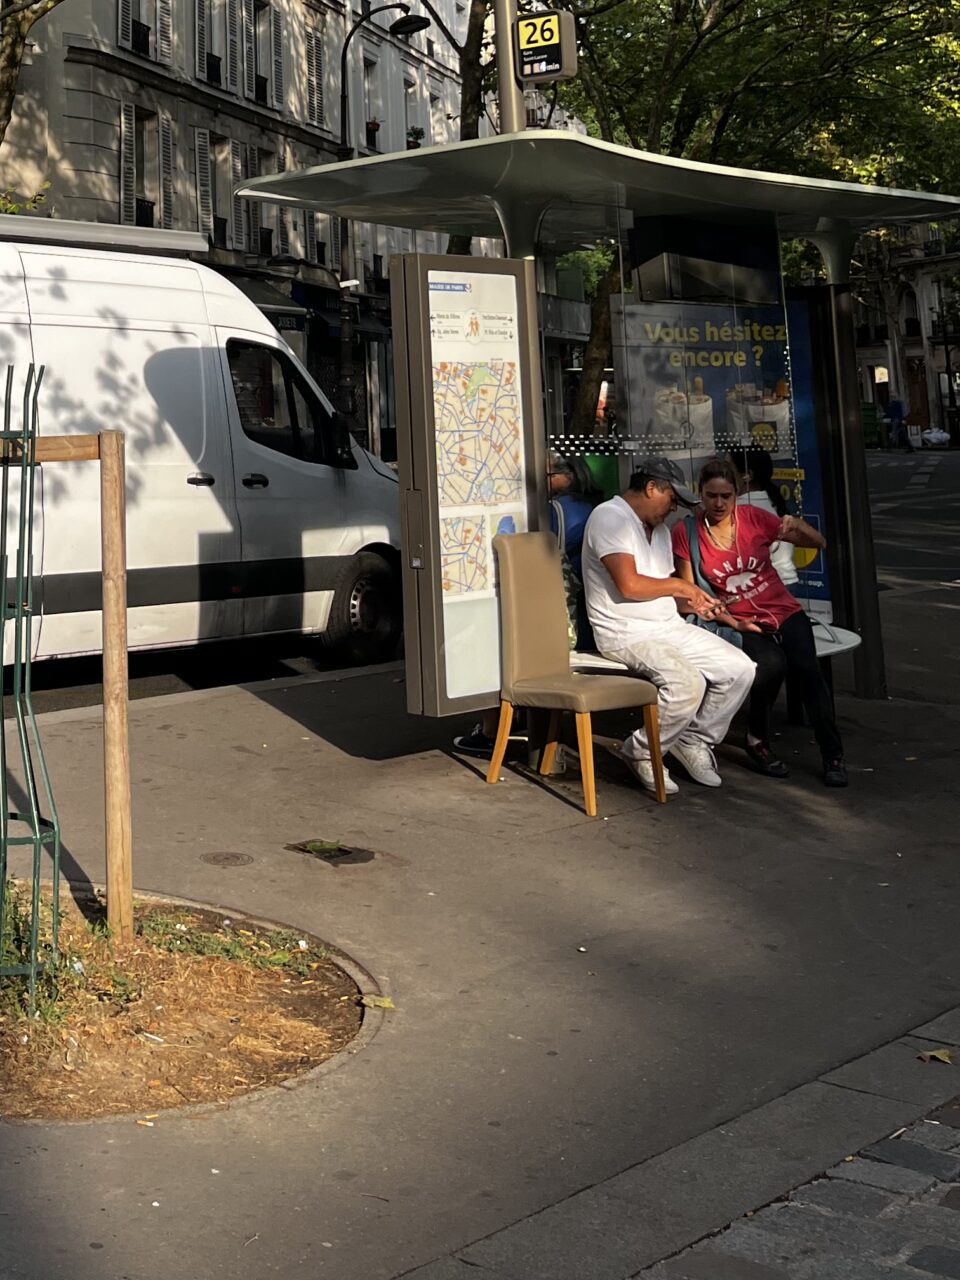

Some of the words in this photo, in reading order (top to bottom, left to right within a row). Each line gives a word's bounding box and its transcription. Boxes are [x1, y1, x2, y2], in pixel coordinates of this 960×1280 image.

[525, 19, 554, 45] 26
[644, 321, 700, 343] Vous
[705, 320, 787, 342] hésitez
[669, 350, 747, 367] encore
[752, 345, 763, 367] ?
